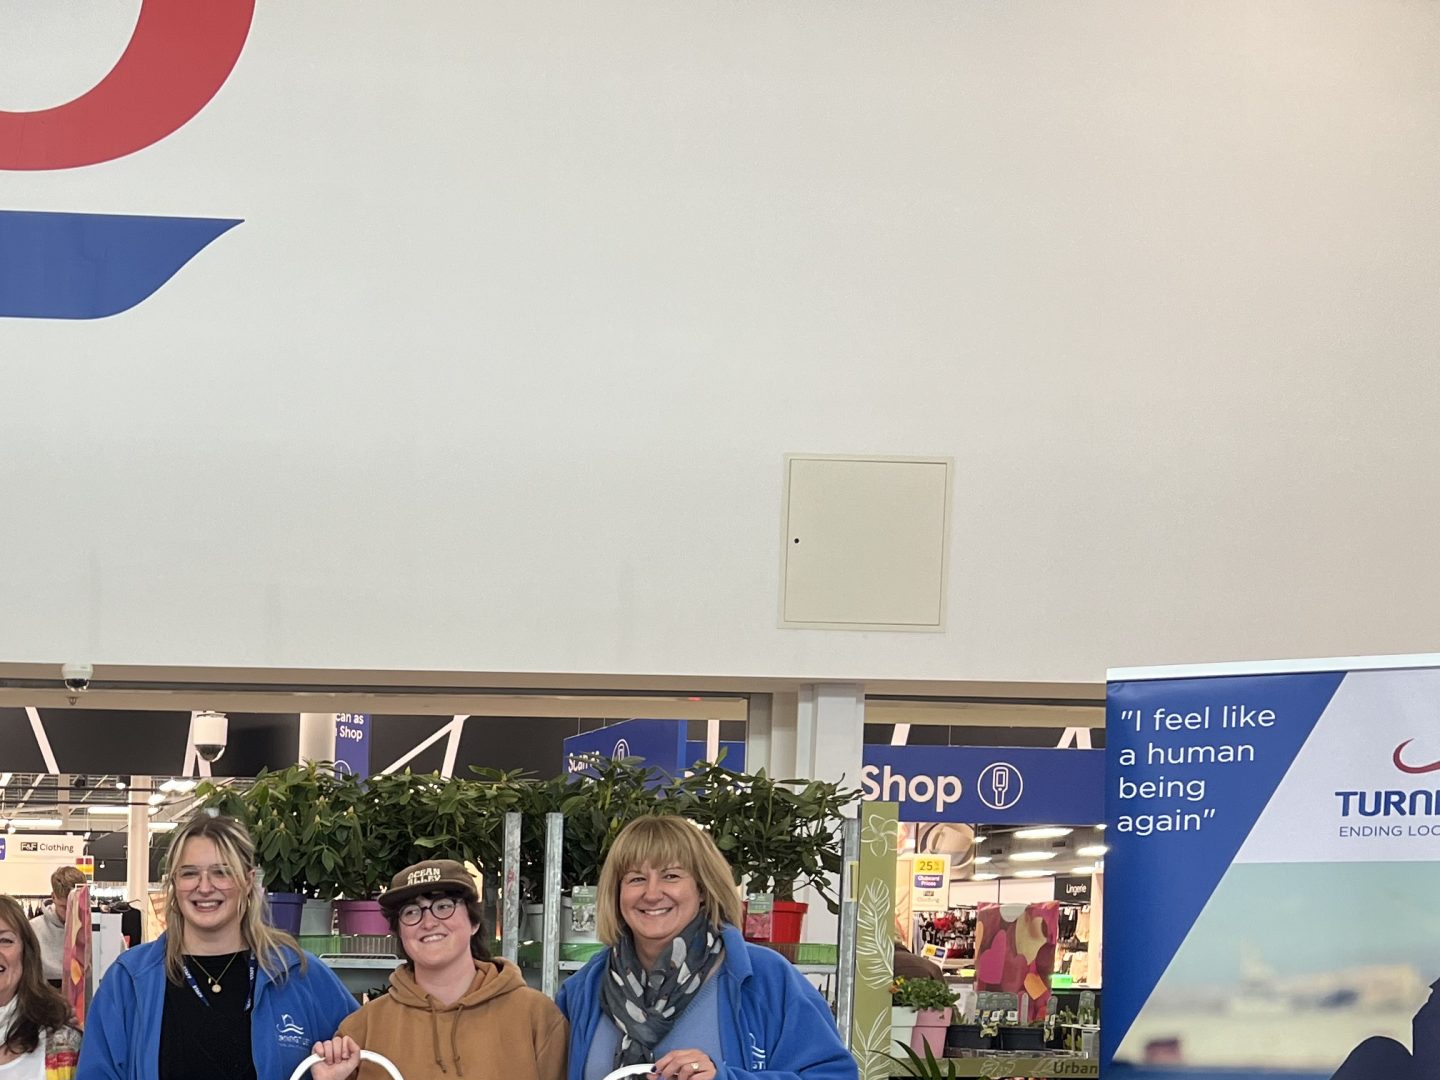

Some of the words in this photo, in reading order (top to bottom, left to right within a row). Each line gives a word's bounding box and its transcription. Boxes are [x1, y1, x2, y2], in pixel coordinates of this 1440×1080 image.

[354, 714, 364, 724] as
[1153, 706, 1209, 731] feel
[1222, 705, 1276, 728] like
[340, 726, 363, 742] Shop
[1119, 749, 1135, 766] a
[1147, 742, 1254, 765] human
[862, 765, 962, 812] Shop
[1119, 776, 1205, 801] being
[1339, 825, 1403, 838] ENDING
[40, 844, 74, 853] Clothing
[408, 868, 440, 879] OCEAN
[1066, 883, 1087, 896] Lingerie
[1053, 1061, 1097, 1075] Urban
